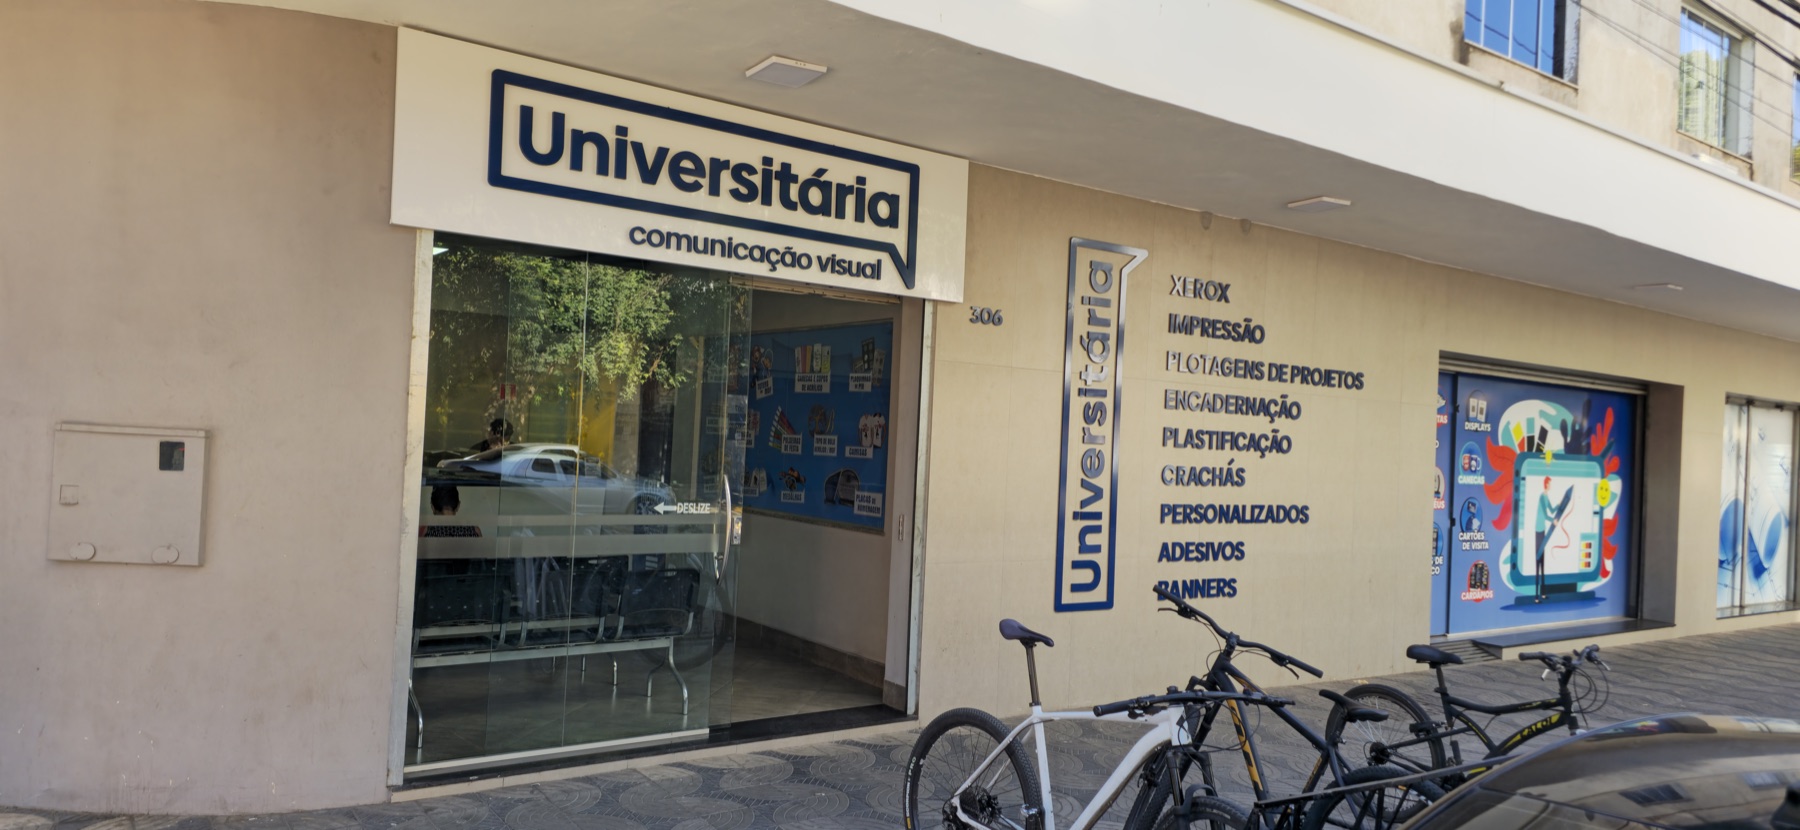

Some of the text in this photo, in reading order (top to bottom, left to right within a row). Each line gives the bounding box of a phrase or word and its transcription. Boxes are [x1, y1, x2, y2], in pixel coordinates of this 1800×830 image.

[518, 105, 901, 230] Universitária
[629, 225, 882, 282] comunicação visual
[1170, 274, 1231, 304] XEROX
[968, 306, 1004, 327] 306
[1168, 313, 1265, 345] IMPRESSÃO
[1165, 350, 1365, 391] PLOTAGENS DE PROJETOS
[1163, 389, 1302, 423] ENCADERNAÇÃO
[1069, 259, 1114, 594] Universitária
[1464, 421, 1491, 433] DISPLAYS
[1161, 426, 1293, 459] PLASTIFICAÇÃO
[1160, 458, 1247, 488] CRACHÁS
[1457, 474, 1486, 485] CANECAS
[676, 502, 711, 514] DESLIZE
[1159, 503, 1310, 525] PERSONALIZADOS
[1458, 529, 1485, 541] CARTÕES
[1462, 541, 1490, 551] DE VISITA
[1157, 541, 1246, 563] ADESIVOS
[1157, 577, 1238, 601] BANNERS
[1461, 588, 1494, 601] CARDÁPIOS
